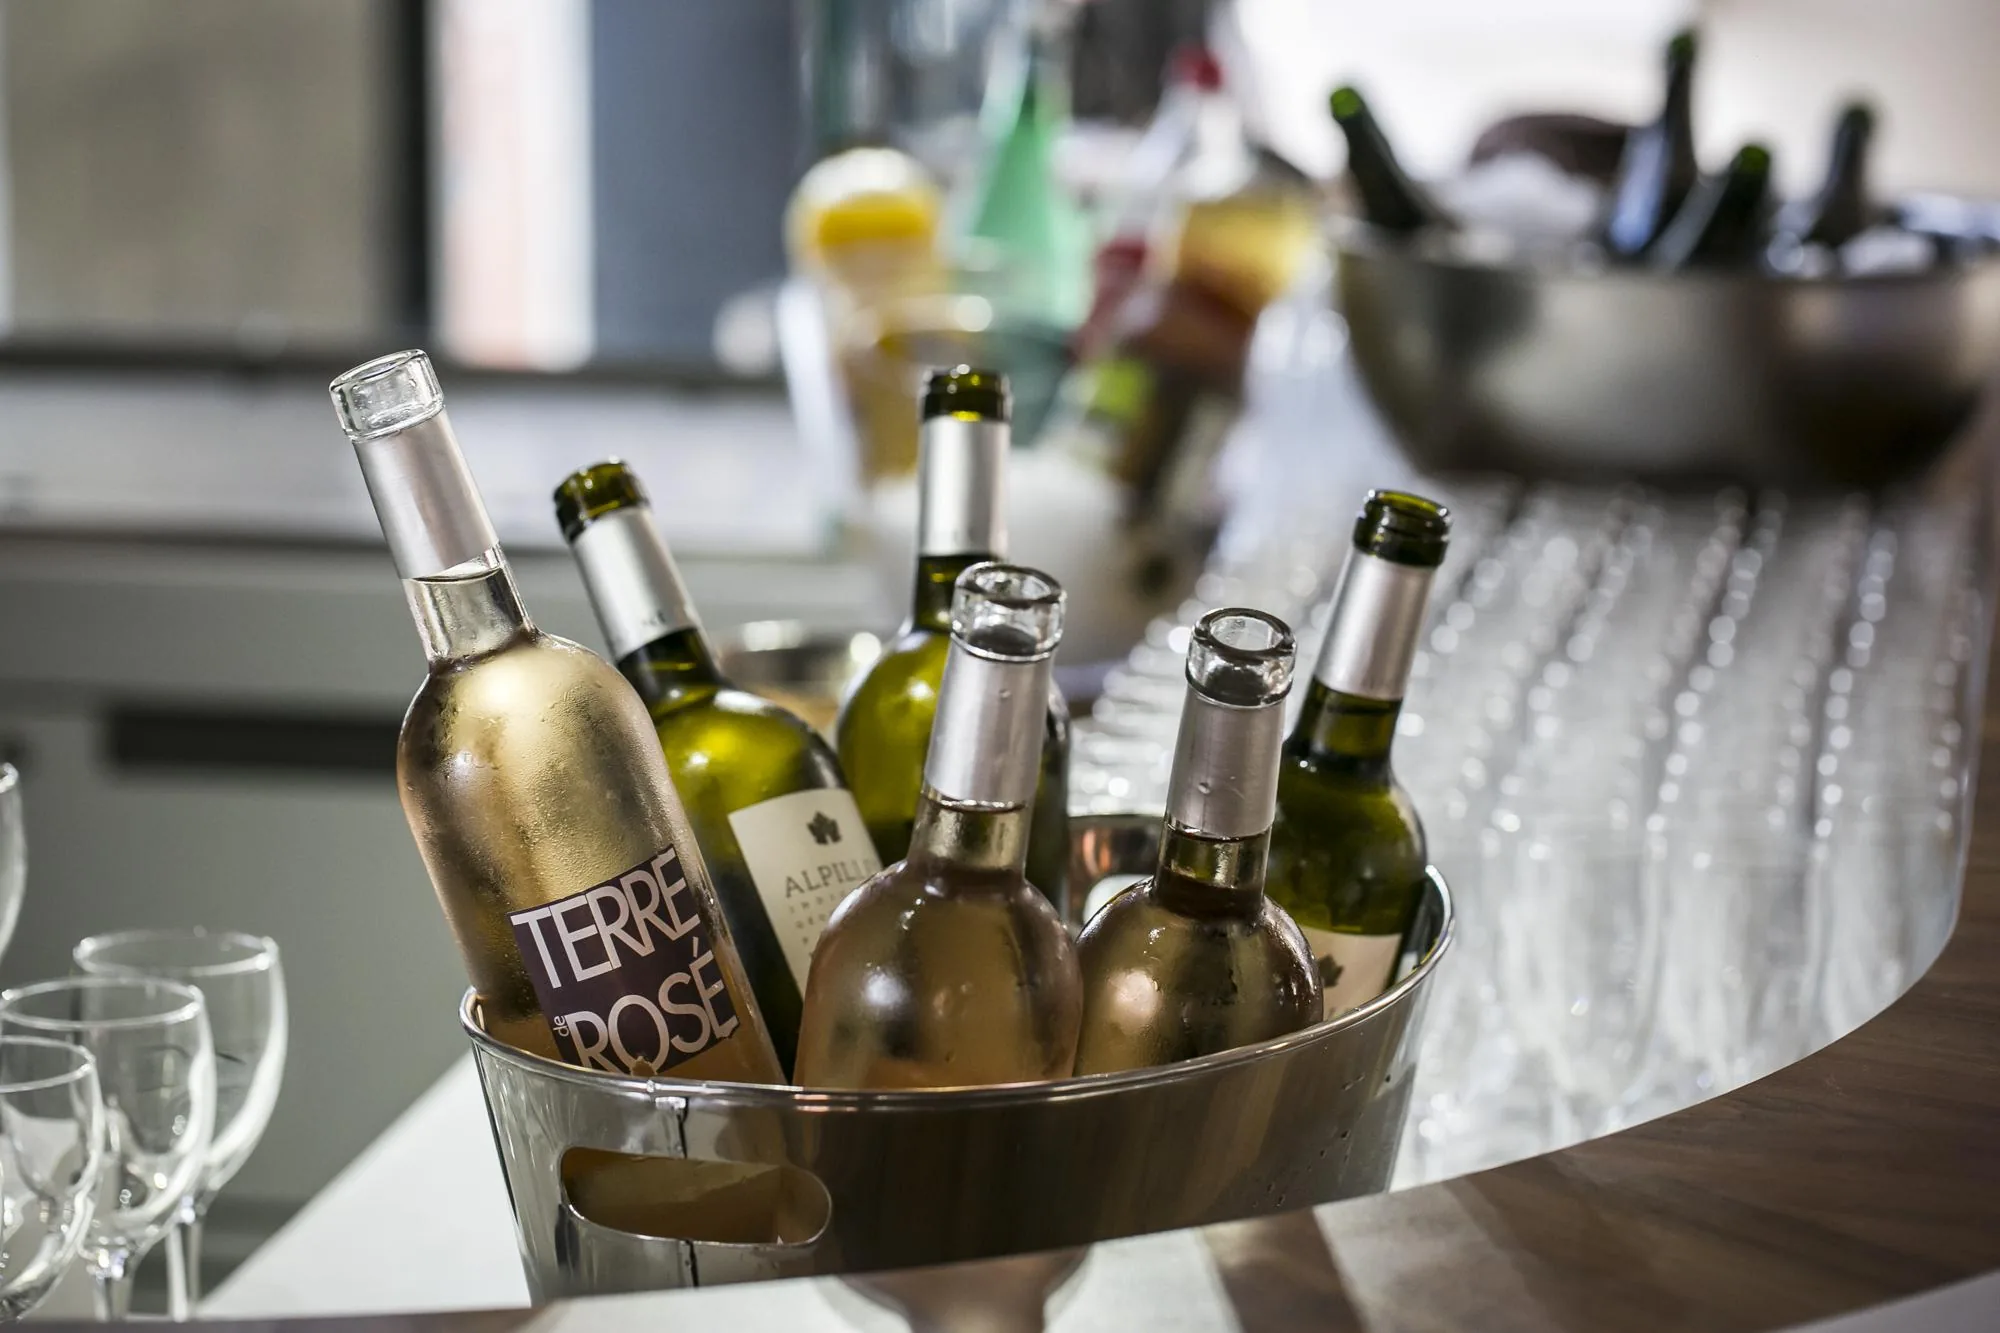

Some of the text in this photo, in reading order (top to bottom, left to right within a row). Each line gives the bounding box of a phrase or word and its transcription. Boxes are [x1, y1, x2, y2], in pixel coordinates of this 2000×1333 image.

[510, 847, 700, 989] TERRE
[553, 1015, 569, 1037] de
[564, 936, 739, 1076] ROSÉ
